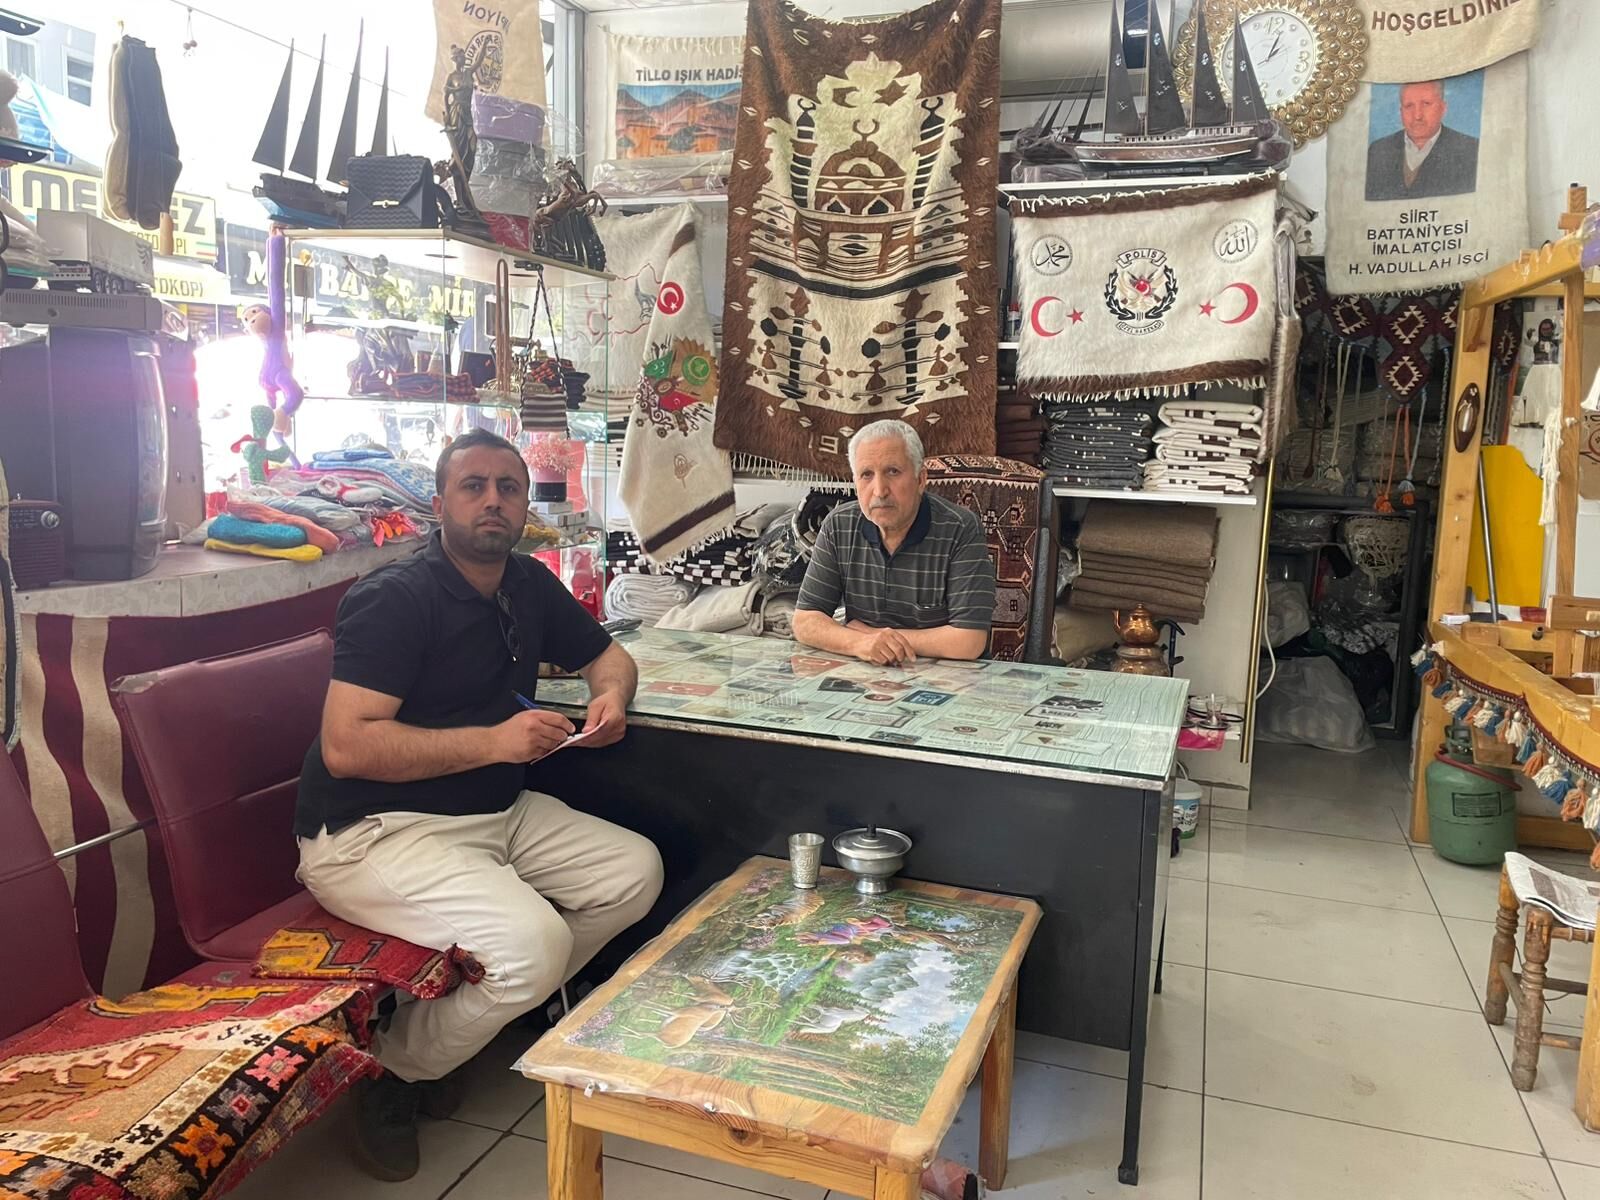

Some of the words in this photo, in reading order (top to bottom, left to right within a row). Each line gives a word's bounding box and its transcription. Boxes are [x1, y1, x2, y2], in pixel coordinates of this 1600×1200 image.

[636, 67, 671, 82] TİLLO
[674, 69, 702, 84] IŞIK
[1399, 209, 1438, 224] SİİRT
[1367, 219, 1468, 241] BATTANİYESİ
[1372, 238, 1462, 255] İMALATÇISI
[1349, 263, 1363, 275] H.
[1367, 257, 1452, 275] VADULLAH
